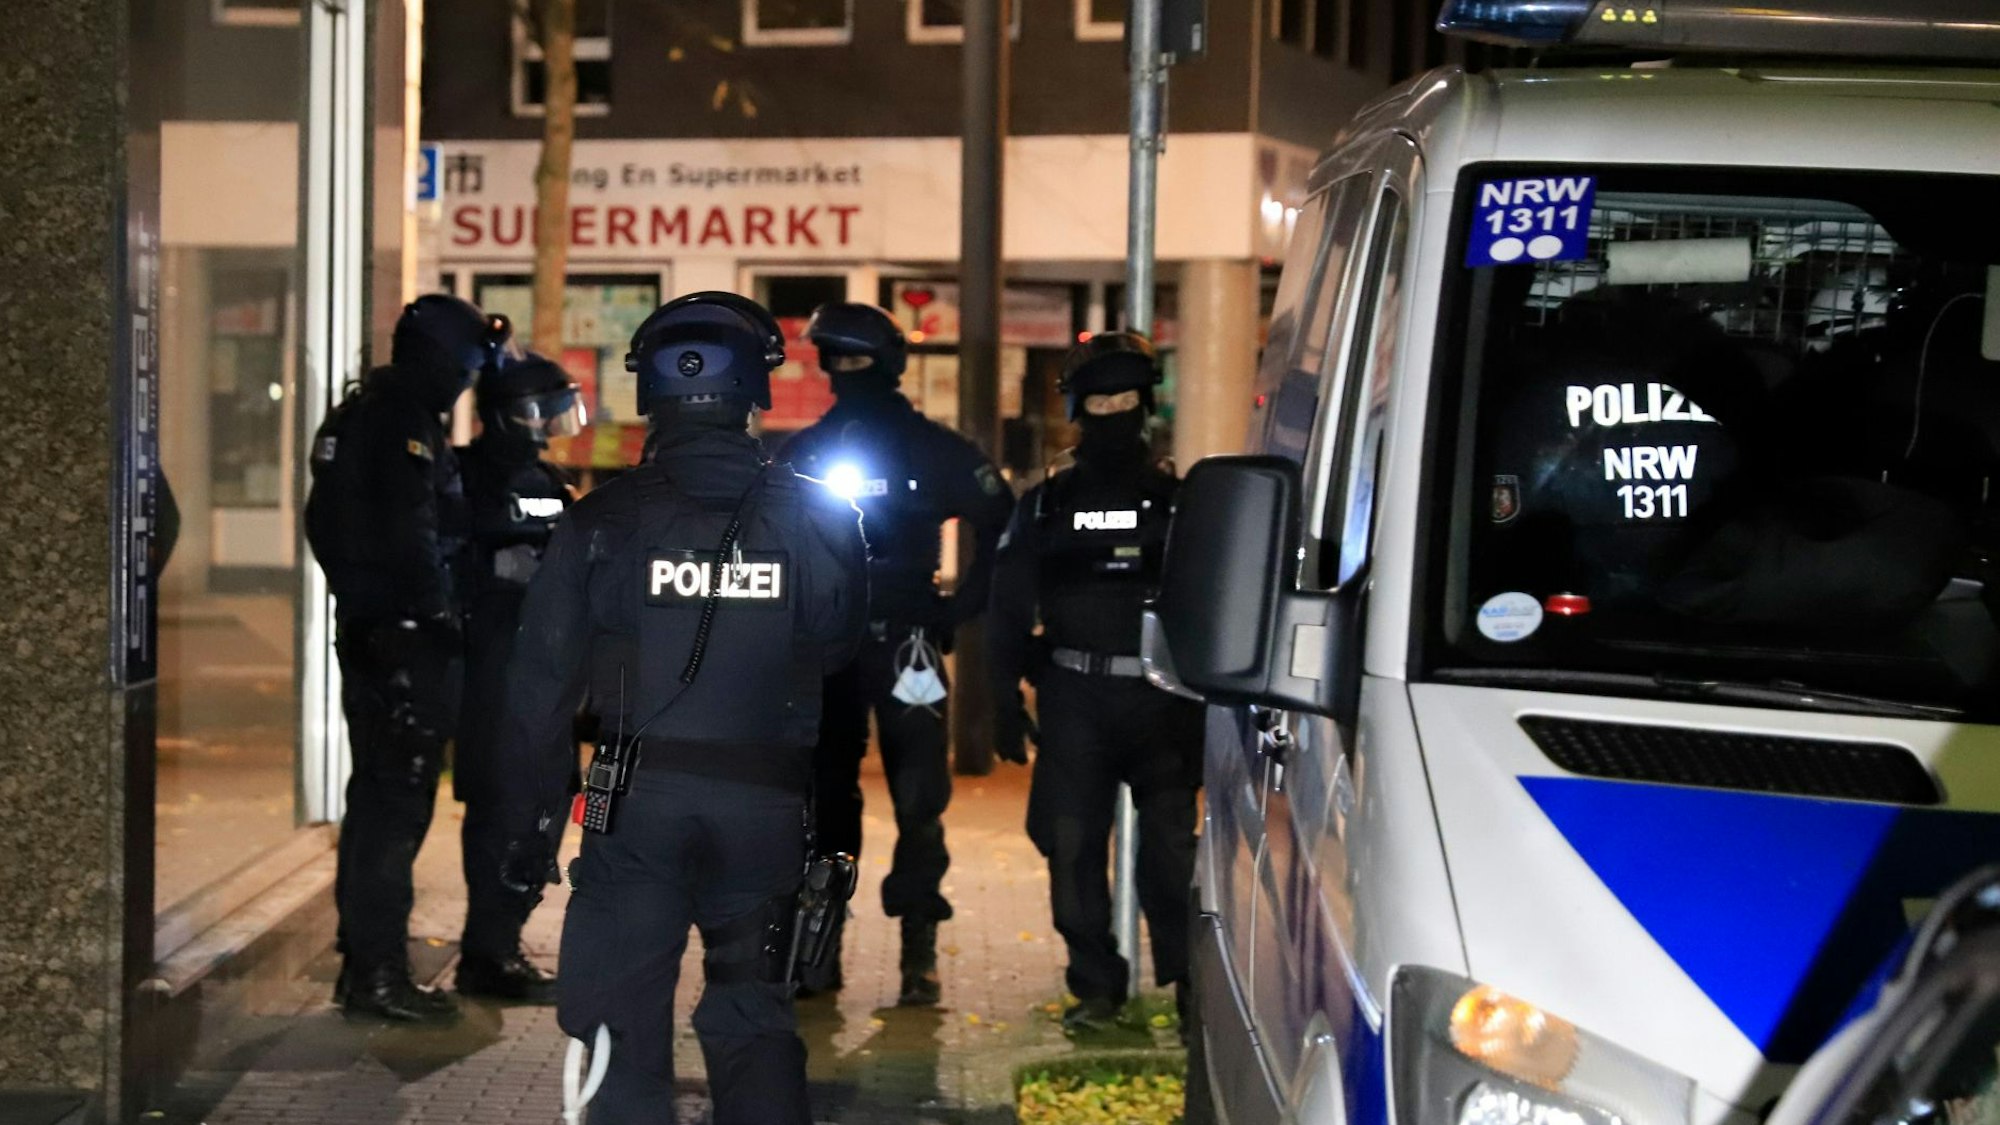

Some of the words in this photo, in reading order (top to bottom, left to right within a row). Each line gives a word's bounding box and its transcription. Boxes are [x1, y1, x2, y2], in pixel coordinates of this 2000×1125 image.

[621, 163, 656, 184] En
[668, 162, 862, 190] Supermarket
[1481, 177, 1591, 207] NRW
[452, 204, 861, 246] SUERMARKT
[1486, 205, 1578, 235] 1311
[1603, 445, 1698, 481] NRW
[1616, 484, 1688, 519] 1311
